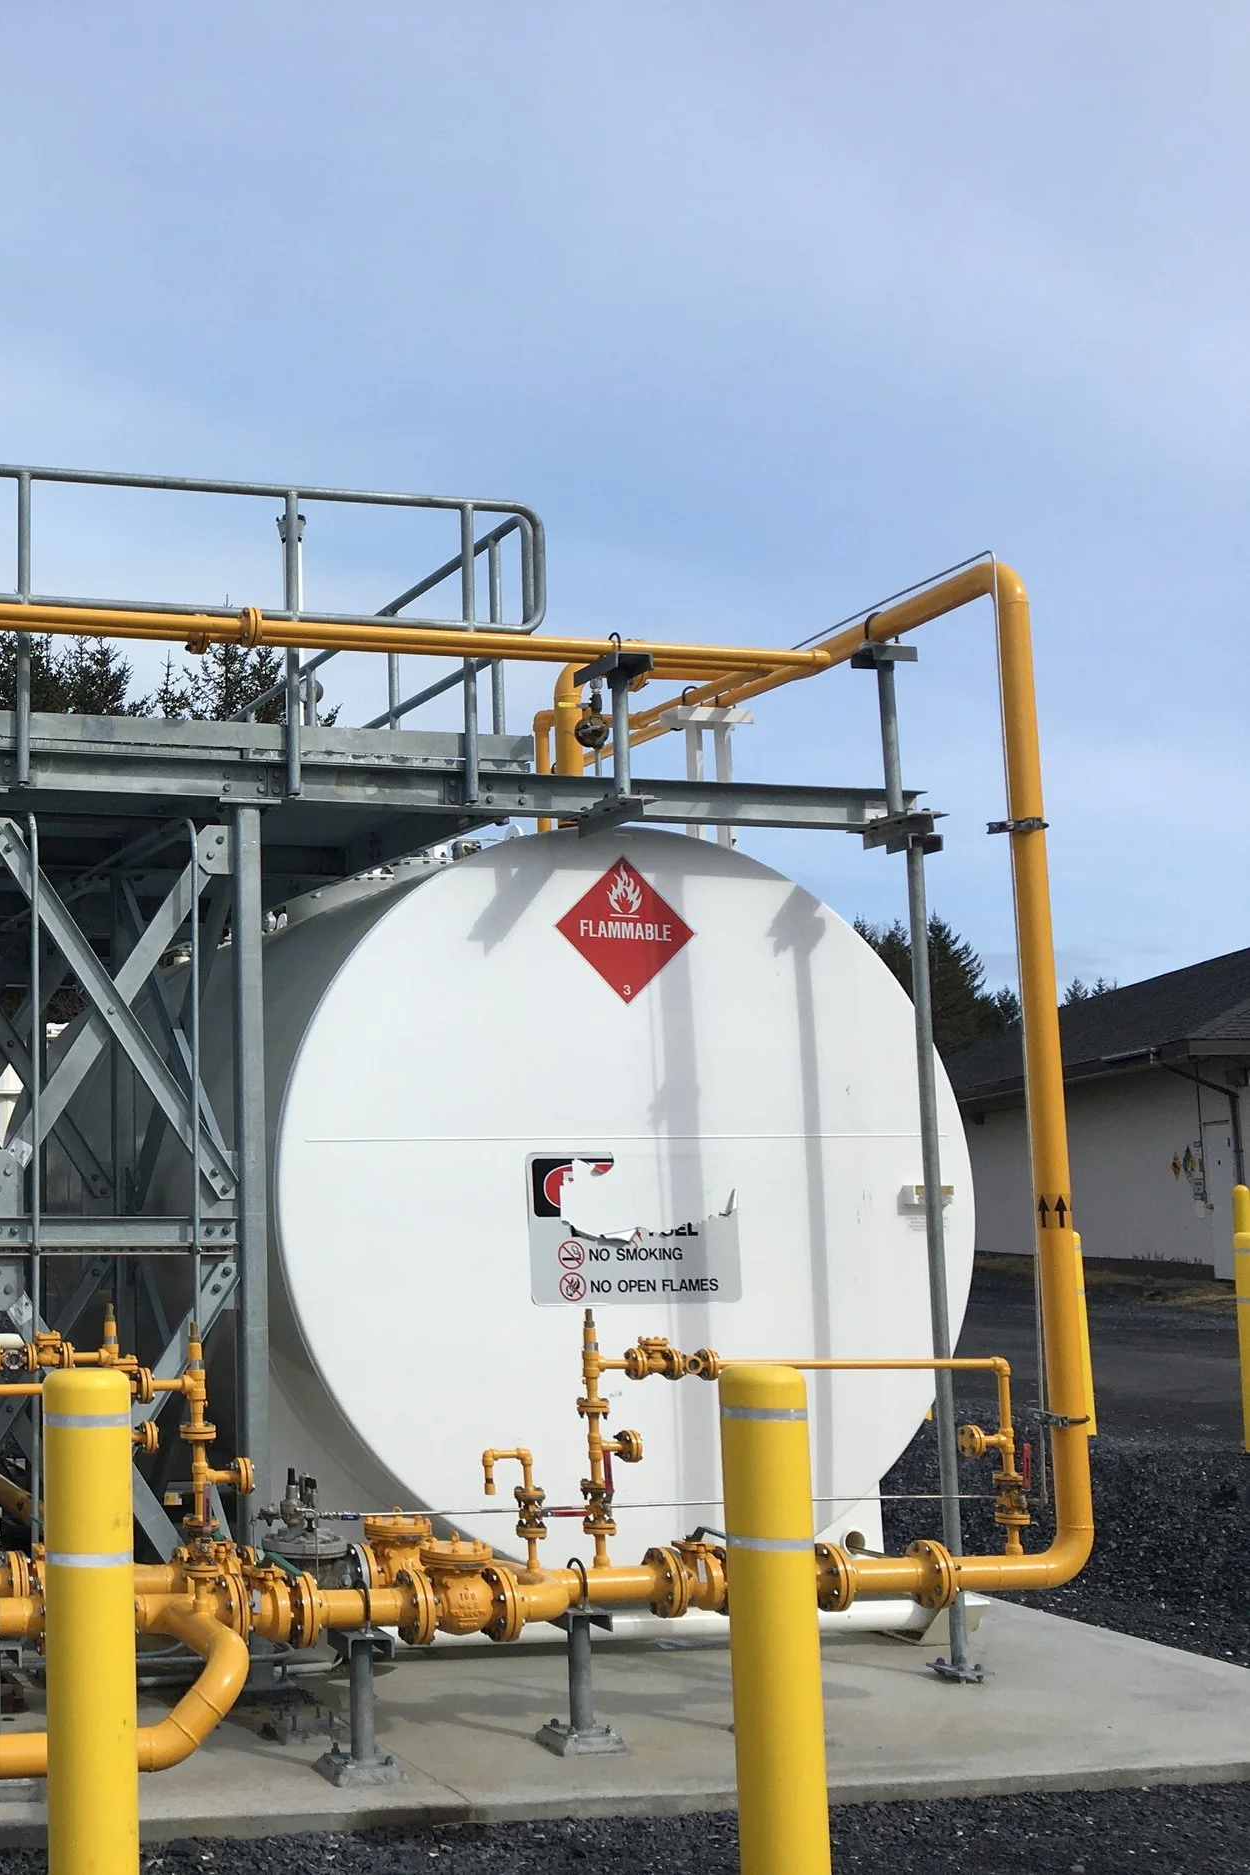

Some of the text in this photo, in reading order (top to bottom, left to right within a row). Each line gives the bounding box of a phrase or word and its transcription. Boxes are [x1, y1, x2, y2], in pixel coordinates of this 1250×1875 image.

[580, 919, 672, 942] FLAMMABLE
[623, 985, 632, 996] 3
[589, 1247, 683, 1261] NO SMOKING
[590, 1278, 719, 1293] NO OPEN FLAMES
